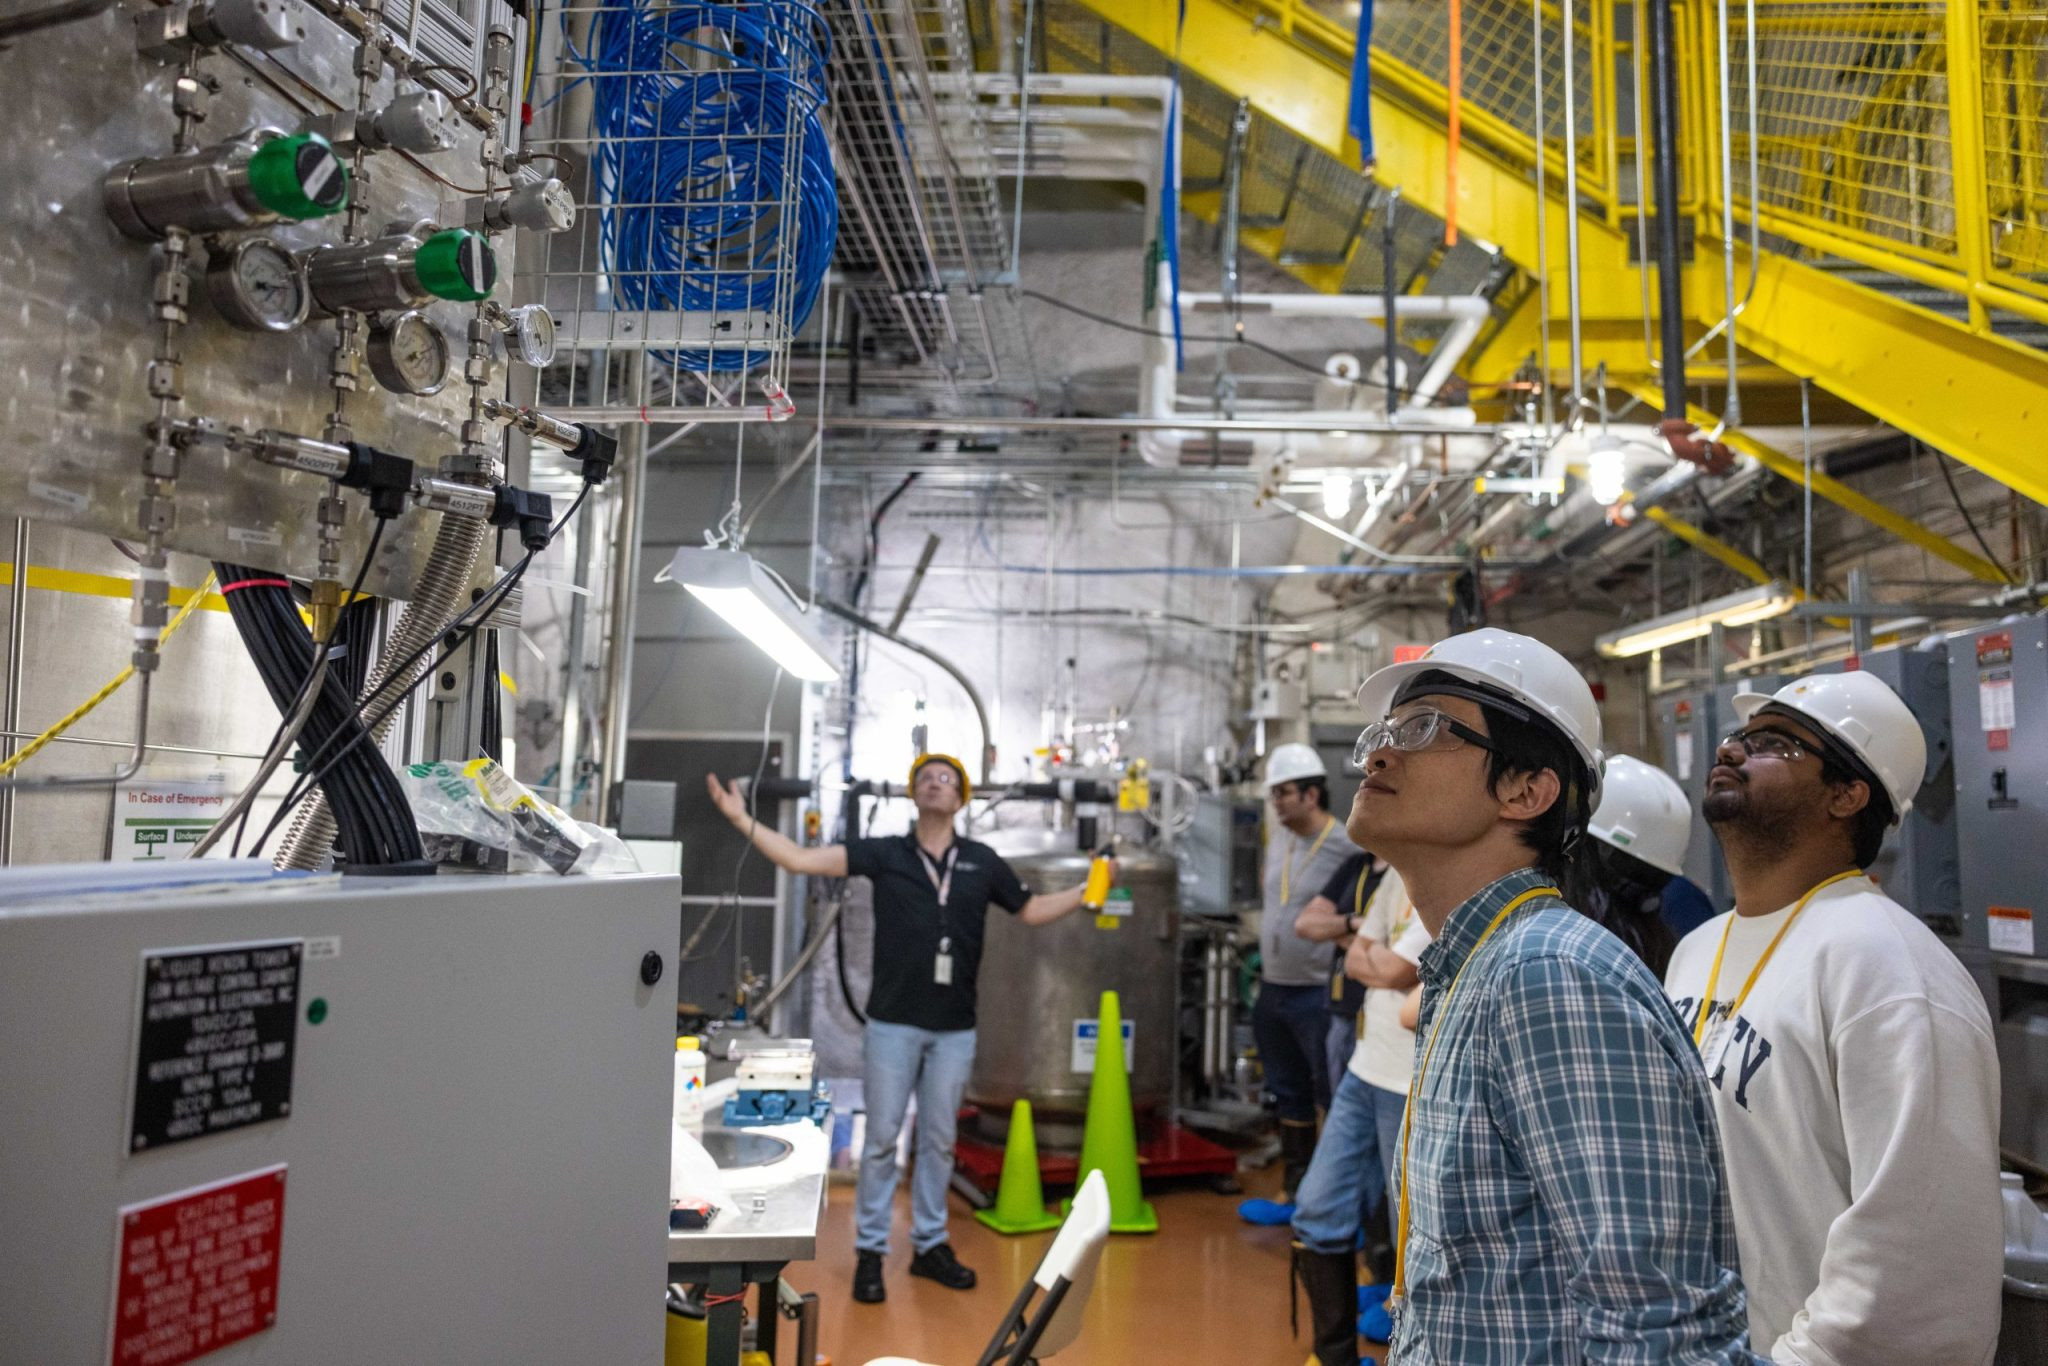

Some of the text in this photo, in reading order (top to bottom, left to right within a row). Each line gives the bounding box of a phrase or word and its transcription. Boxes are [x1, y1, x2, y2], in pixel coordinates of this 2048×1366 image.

[450, 500, 486, 512] 4512PT
[128, 792, 224, 806] In Case of Emergency
[138, 832, 165, 841] Surface
